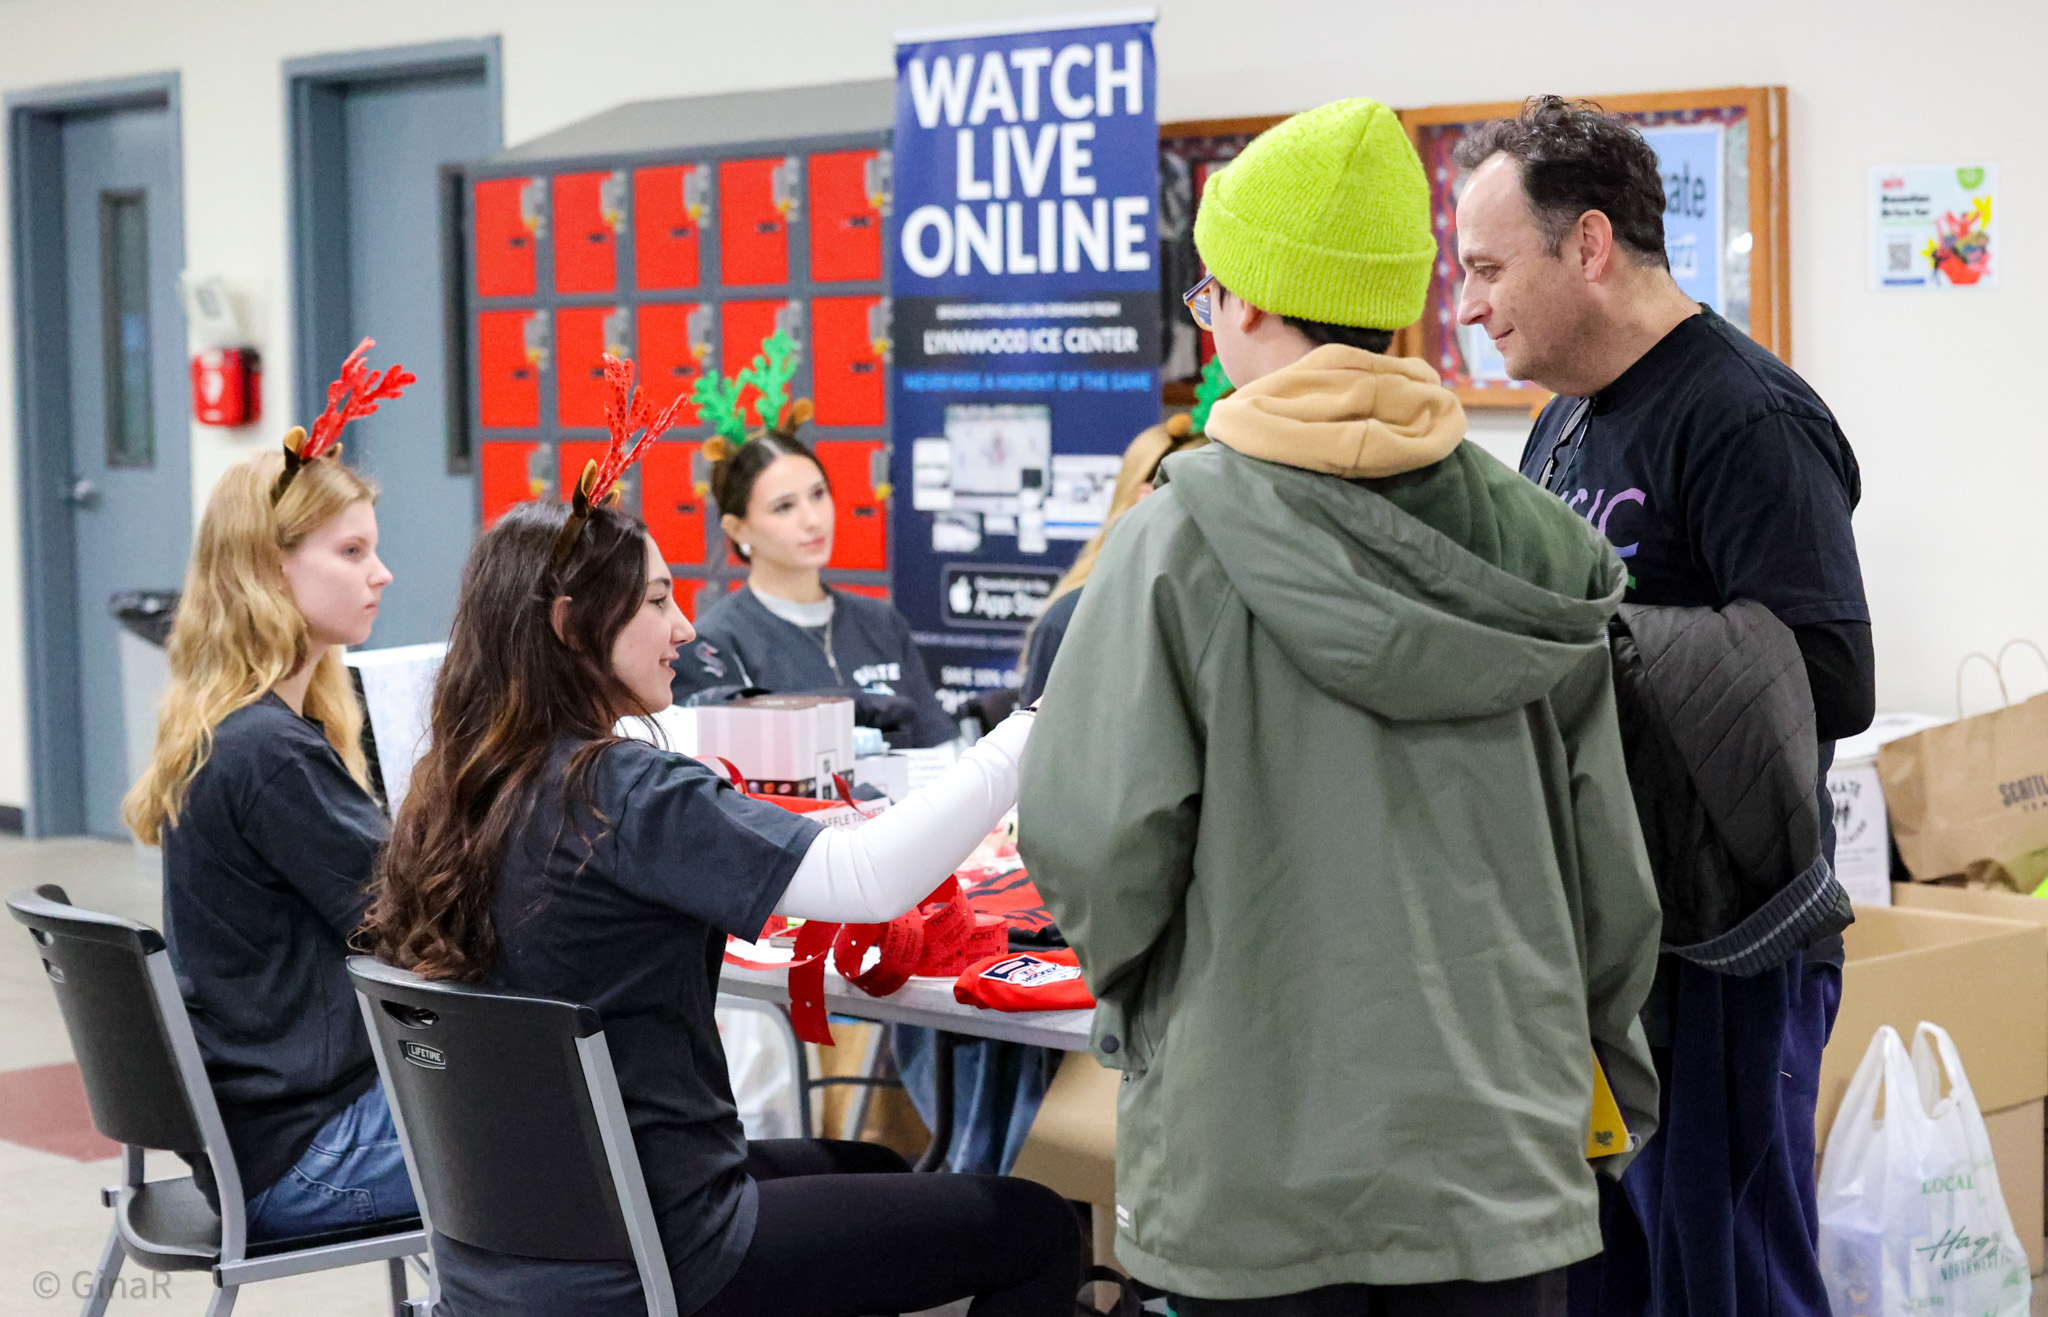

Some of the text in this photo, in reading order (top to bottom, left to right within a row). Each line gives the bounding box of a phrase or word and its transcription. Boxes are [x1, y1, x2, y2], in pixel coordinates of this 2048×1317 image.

[908, 40, 1143, 129] WATCH
[956, 121, 1097, 201] LIVE
[901, 196, 1151, 278] ONLINE
[923, 326, 1139, 355] LYNNWOOD ICE CENTER
[974, 591, 1048, 619] App Sto
[821, 813, 851, 828] AFFLE
[928, 901, 959, 929] TICKET
[971, 929, 996, 942] ICKET
[410, 1045, 442, 1062] LIFETIME
[1921, 1174, 1974, 1195] LOCAL
